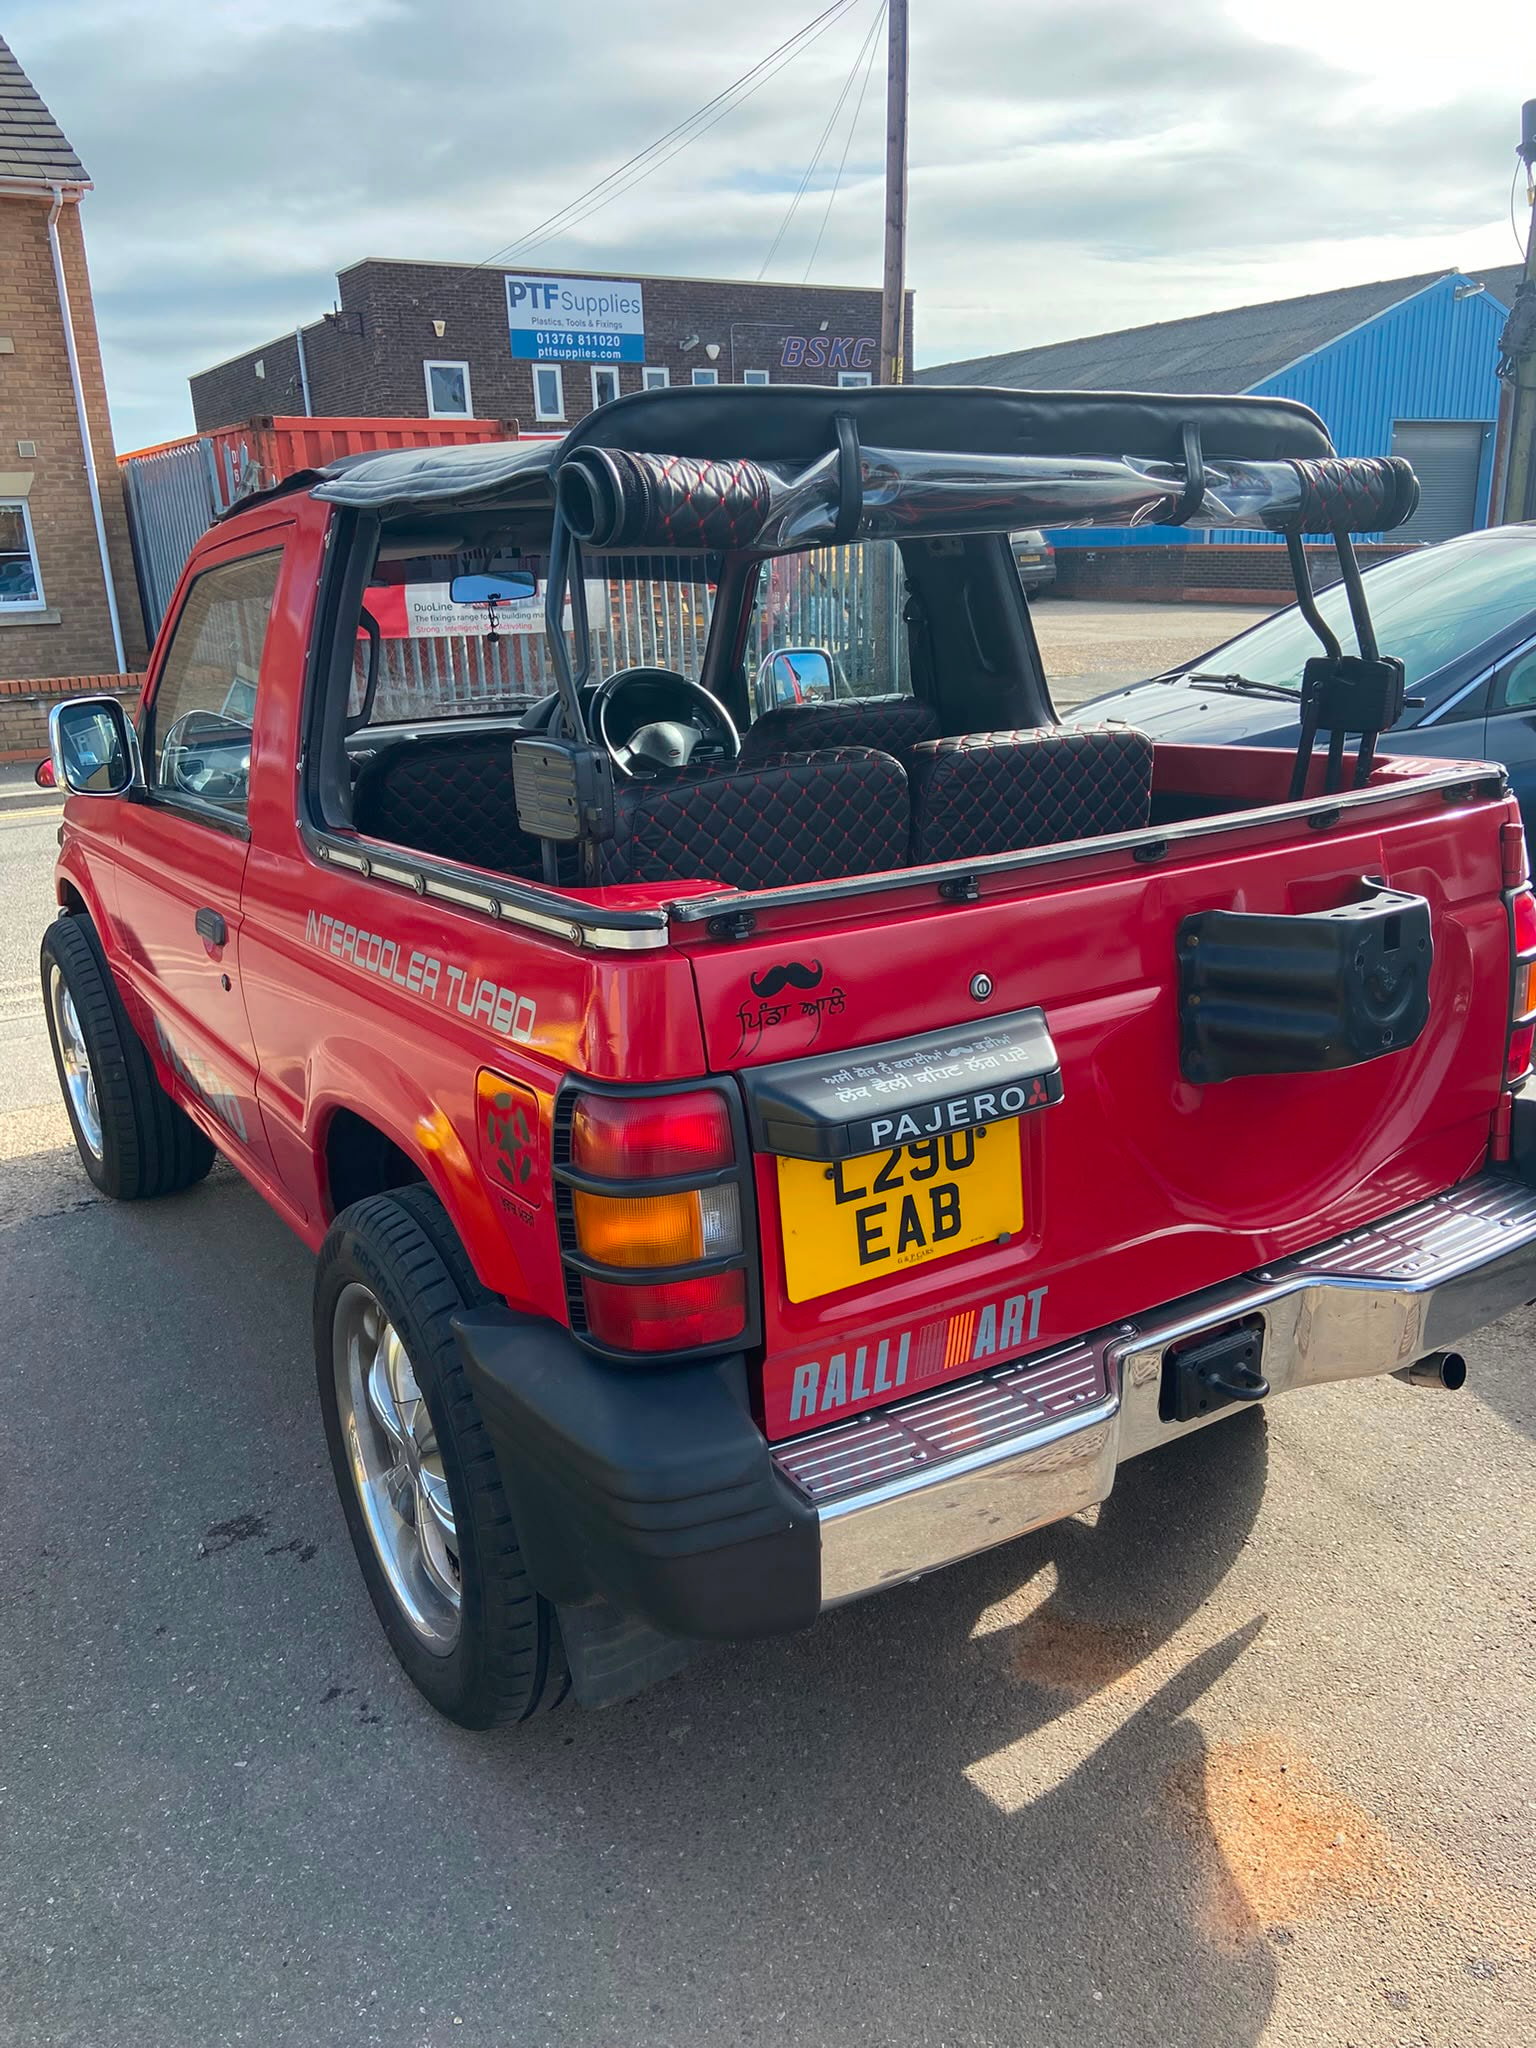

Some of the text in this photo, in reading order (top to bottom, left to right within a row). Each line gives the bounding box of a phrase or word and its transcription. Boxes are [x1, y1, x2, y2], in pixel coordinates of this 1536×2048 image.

[508, 281, 641, 317] PTF Supplies
[531, 317, 623, 330] Plastics, Tools & Fixings
[536, 332, 621, 347] 01376 811020
[538, 347, 621, 360] ptfsupplies.com
[780, 336, 877, 368] BSKC
[414, 602, 453, 612] DuoLine
[430, 614, 456, 622] fixings
[501, 612, 532, 620] building
[415, 625, 440, 633] Strong
[305, 909, 536, 1043] INTERCOOLER TURBO
[871, 1087, 1026, 1146] PAJERO
[834, 1128, 975, 1205] L290
[855, 1182, 962, 1266] EAB
[790, 1286, 1049, 1421] RALLI ART
